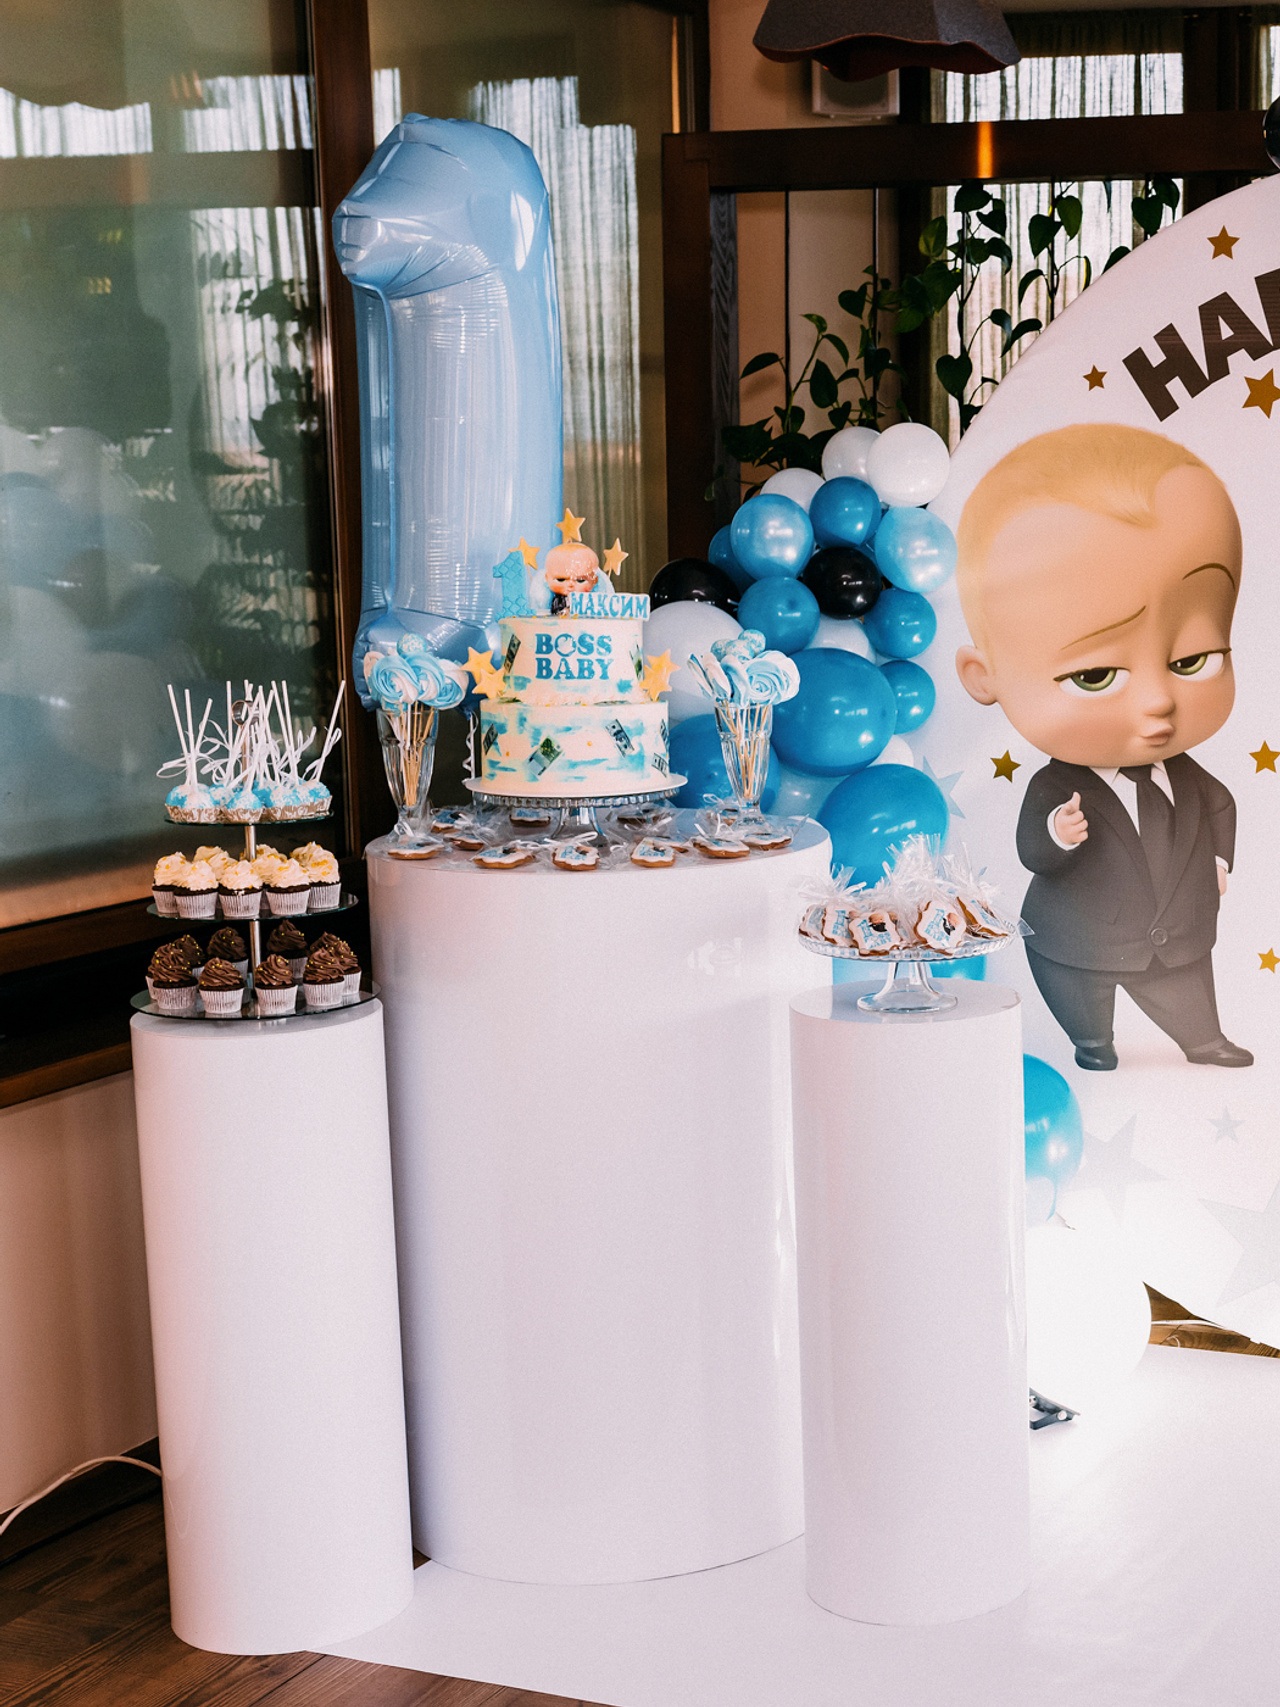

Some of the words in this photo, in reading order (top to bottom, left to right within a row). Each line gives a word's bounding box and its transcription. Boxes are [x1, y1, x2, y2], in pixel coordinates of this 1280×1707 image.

[570, 591, 649, 618] МАКСИМ
[535, 633, 613, 657] BOSS
[535, 657, 614, 680] BABY
